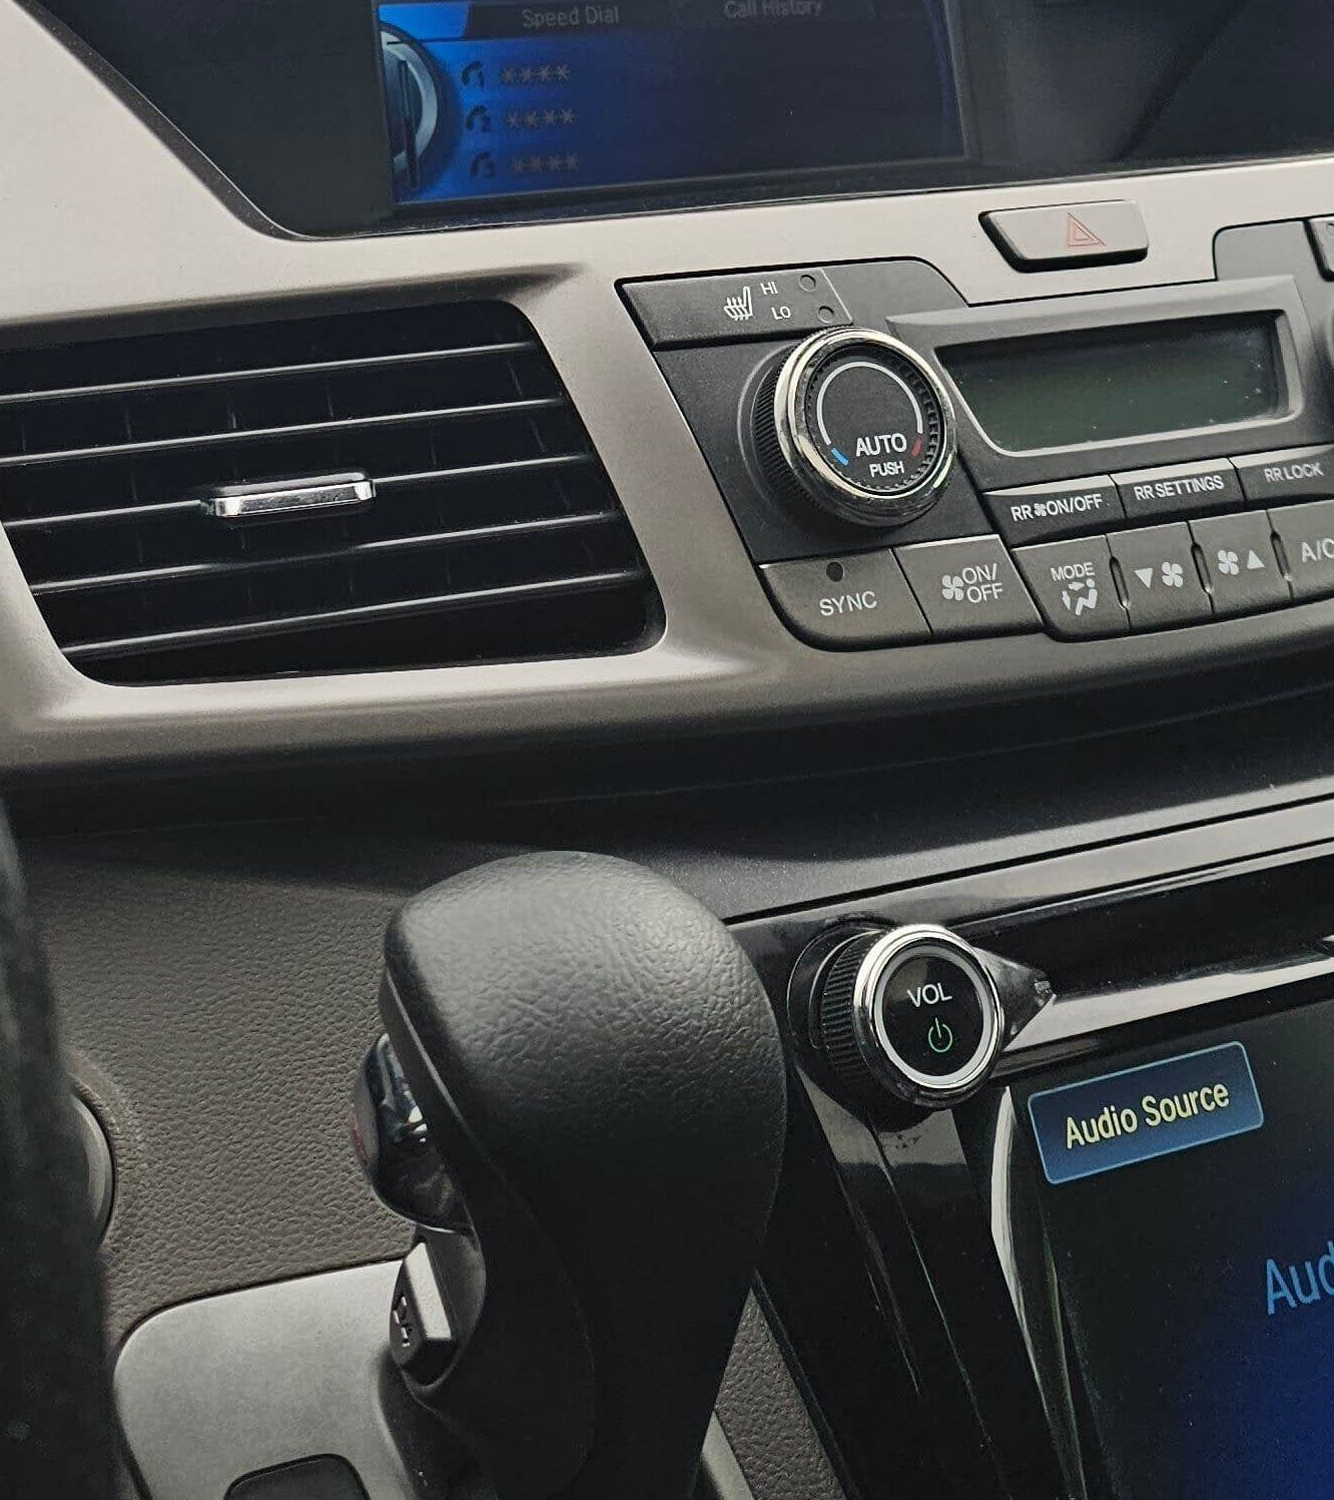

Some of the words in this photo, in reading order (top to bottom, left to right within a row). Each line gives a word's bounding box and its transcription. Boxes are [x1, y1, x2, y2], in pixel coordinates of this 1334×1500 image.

[521, 7, 580, 30] Speed
[585, 5, 620, 26] Dial
[723, 0, 758, 19] Call
[762, 0, 824, 18] History
[760, 281, 778, 296] HI
[771, 305, 791, 321] LO
[855, 432, 908, 458] AUTO
[869, 460, 905, 479] PUSH
[1263, 466, 1283, 483] RR
[1283, 461, 1324, 481] LOCK
[1133, 484, 1155, 502] RR
[1155, 474, 1225, 499] SETTINGS
[1010, 504, 1034, 523] RR
[1046, 493, 1104, 517] ON/OFF
[962, 563, 998, 586] ON/
[1050, 561, 1096, 582] MODE
[819, 591, 878, 617] SYNC
[967, 582, 1004, 604] OFF
[906, 982, 953, 1008] VOL
[1066, 1104, 1138, 1150] Audio
[1141, 1083, 1230, 1127] Source
